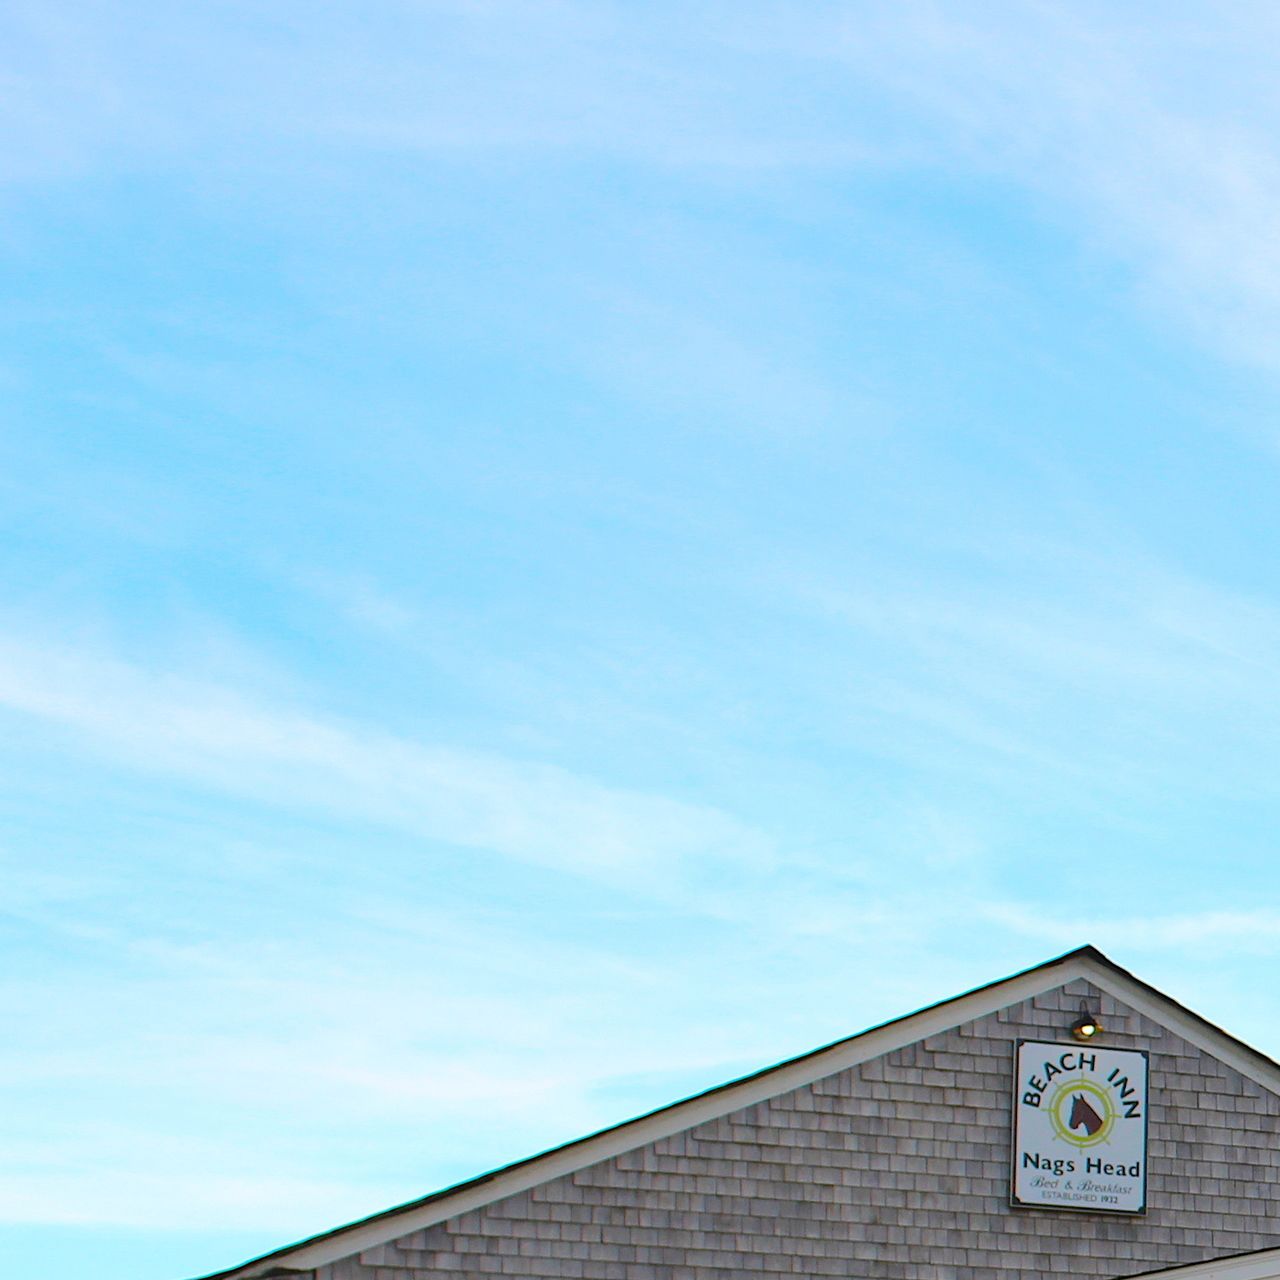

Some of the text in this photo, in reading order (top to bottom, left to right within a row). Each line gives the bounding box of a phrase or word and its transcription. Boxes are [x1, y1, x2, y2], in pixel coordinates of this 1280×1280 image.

[1022, 1053, 1141, 1119] BEACH INN
[1023, 1152, 1140, 1177] Nags Head
[1030, 1176, 1132, 1194] Bed & Breakfast
[1041, 1190, 1097, 1202] ESTABLISHED
